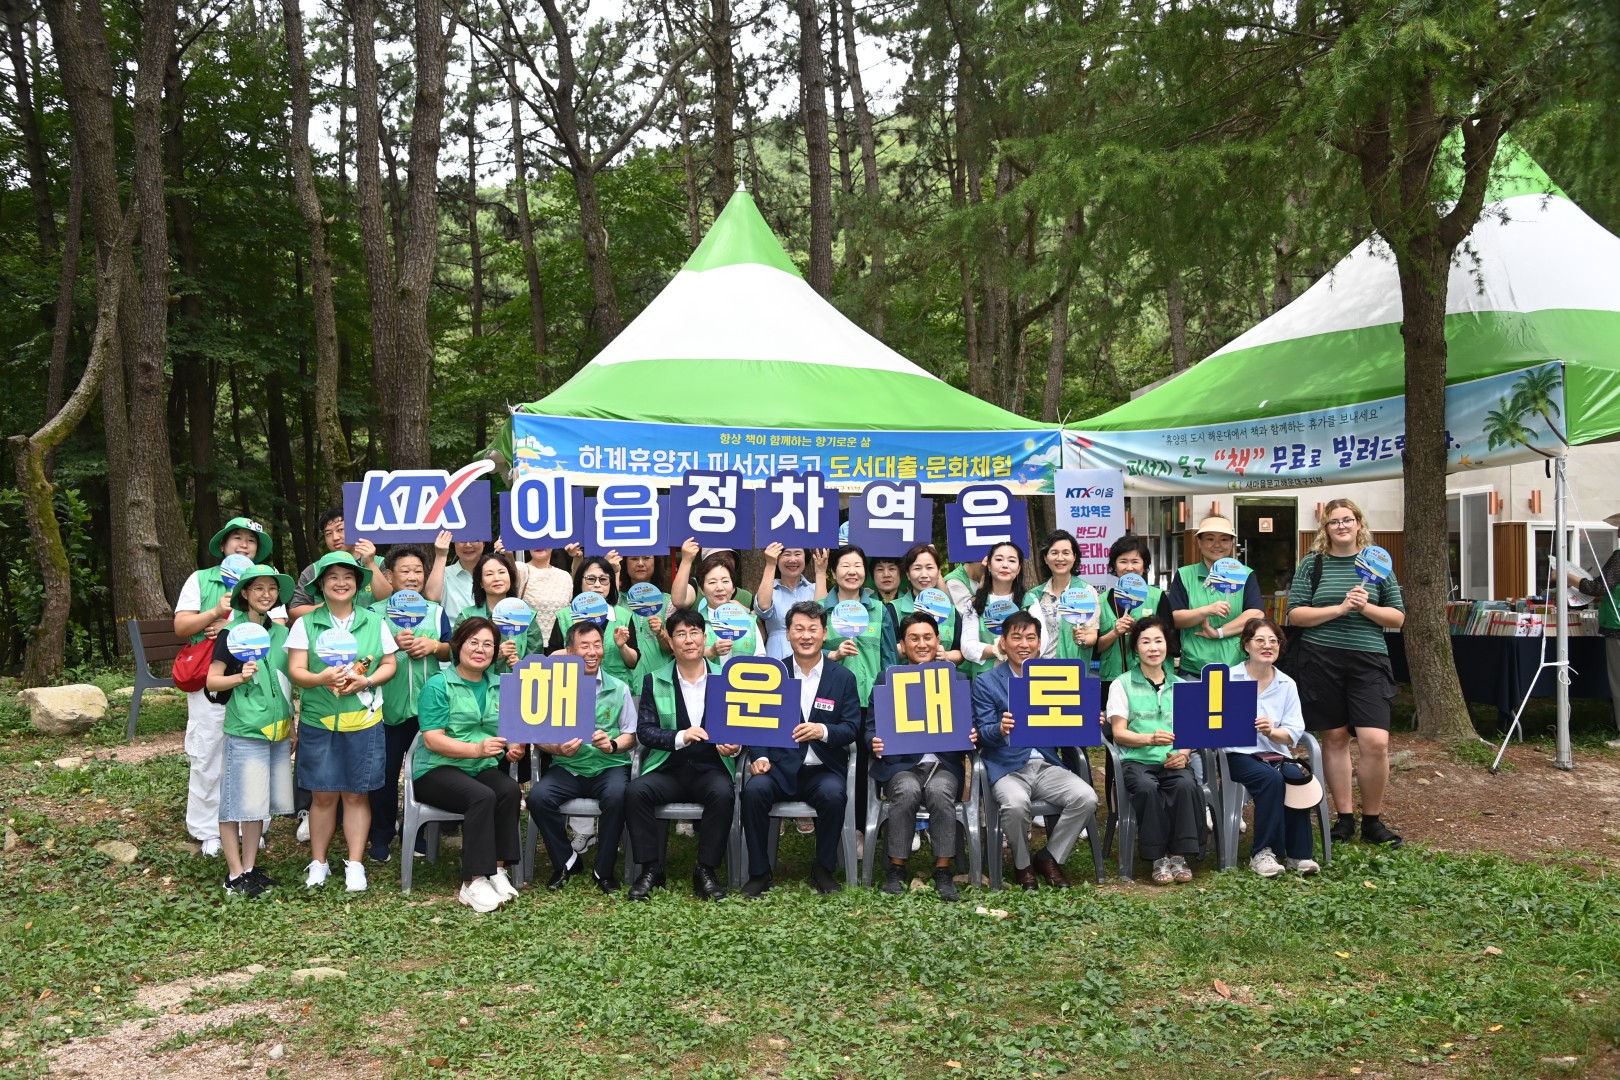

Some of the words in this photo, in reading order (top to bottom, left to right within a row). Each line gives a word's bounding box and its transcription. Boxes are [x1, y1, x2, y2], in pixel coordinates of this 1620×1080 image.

[720, 433, 741, 445] 항상
[745, 434, 766, 446] 책이
[769, 435, 812, 447] 함께하는
[815, 436, 857, 448] 향기로운
[860, 437, 871, 448] 삶
[1190, 432, 1205, 443] 도시
[1208, 427, 1247, 442] 해운대에서
[1250, 424, 1267, 437] 책과
[1270, 420, 1305, 436] 함께하는
[1308, 415, 1336, 430] 휴가를
[578, 445, 699, 474] 하계휴양지
[1126, 459, 1173, 477] 피서지
[1177, 455, 1208, 478] 문고
[1270, 443, 1322, 474] 무료로
[355, 459, 495, 531] KTX
[1070, 505, 1111, 518] 정차역은
[1076, 526, 1107, 539] 반드시
